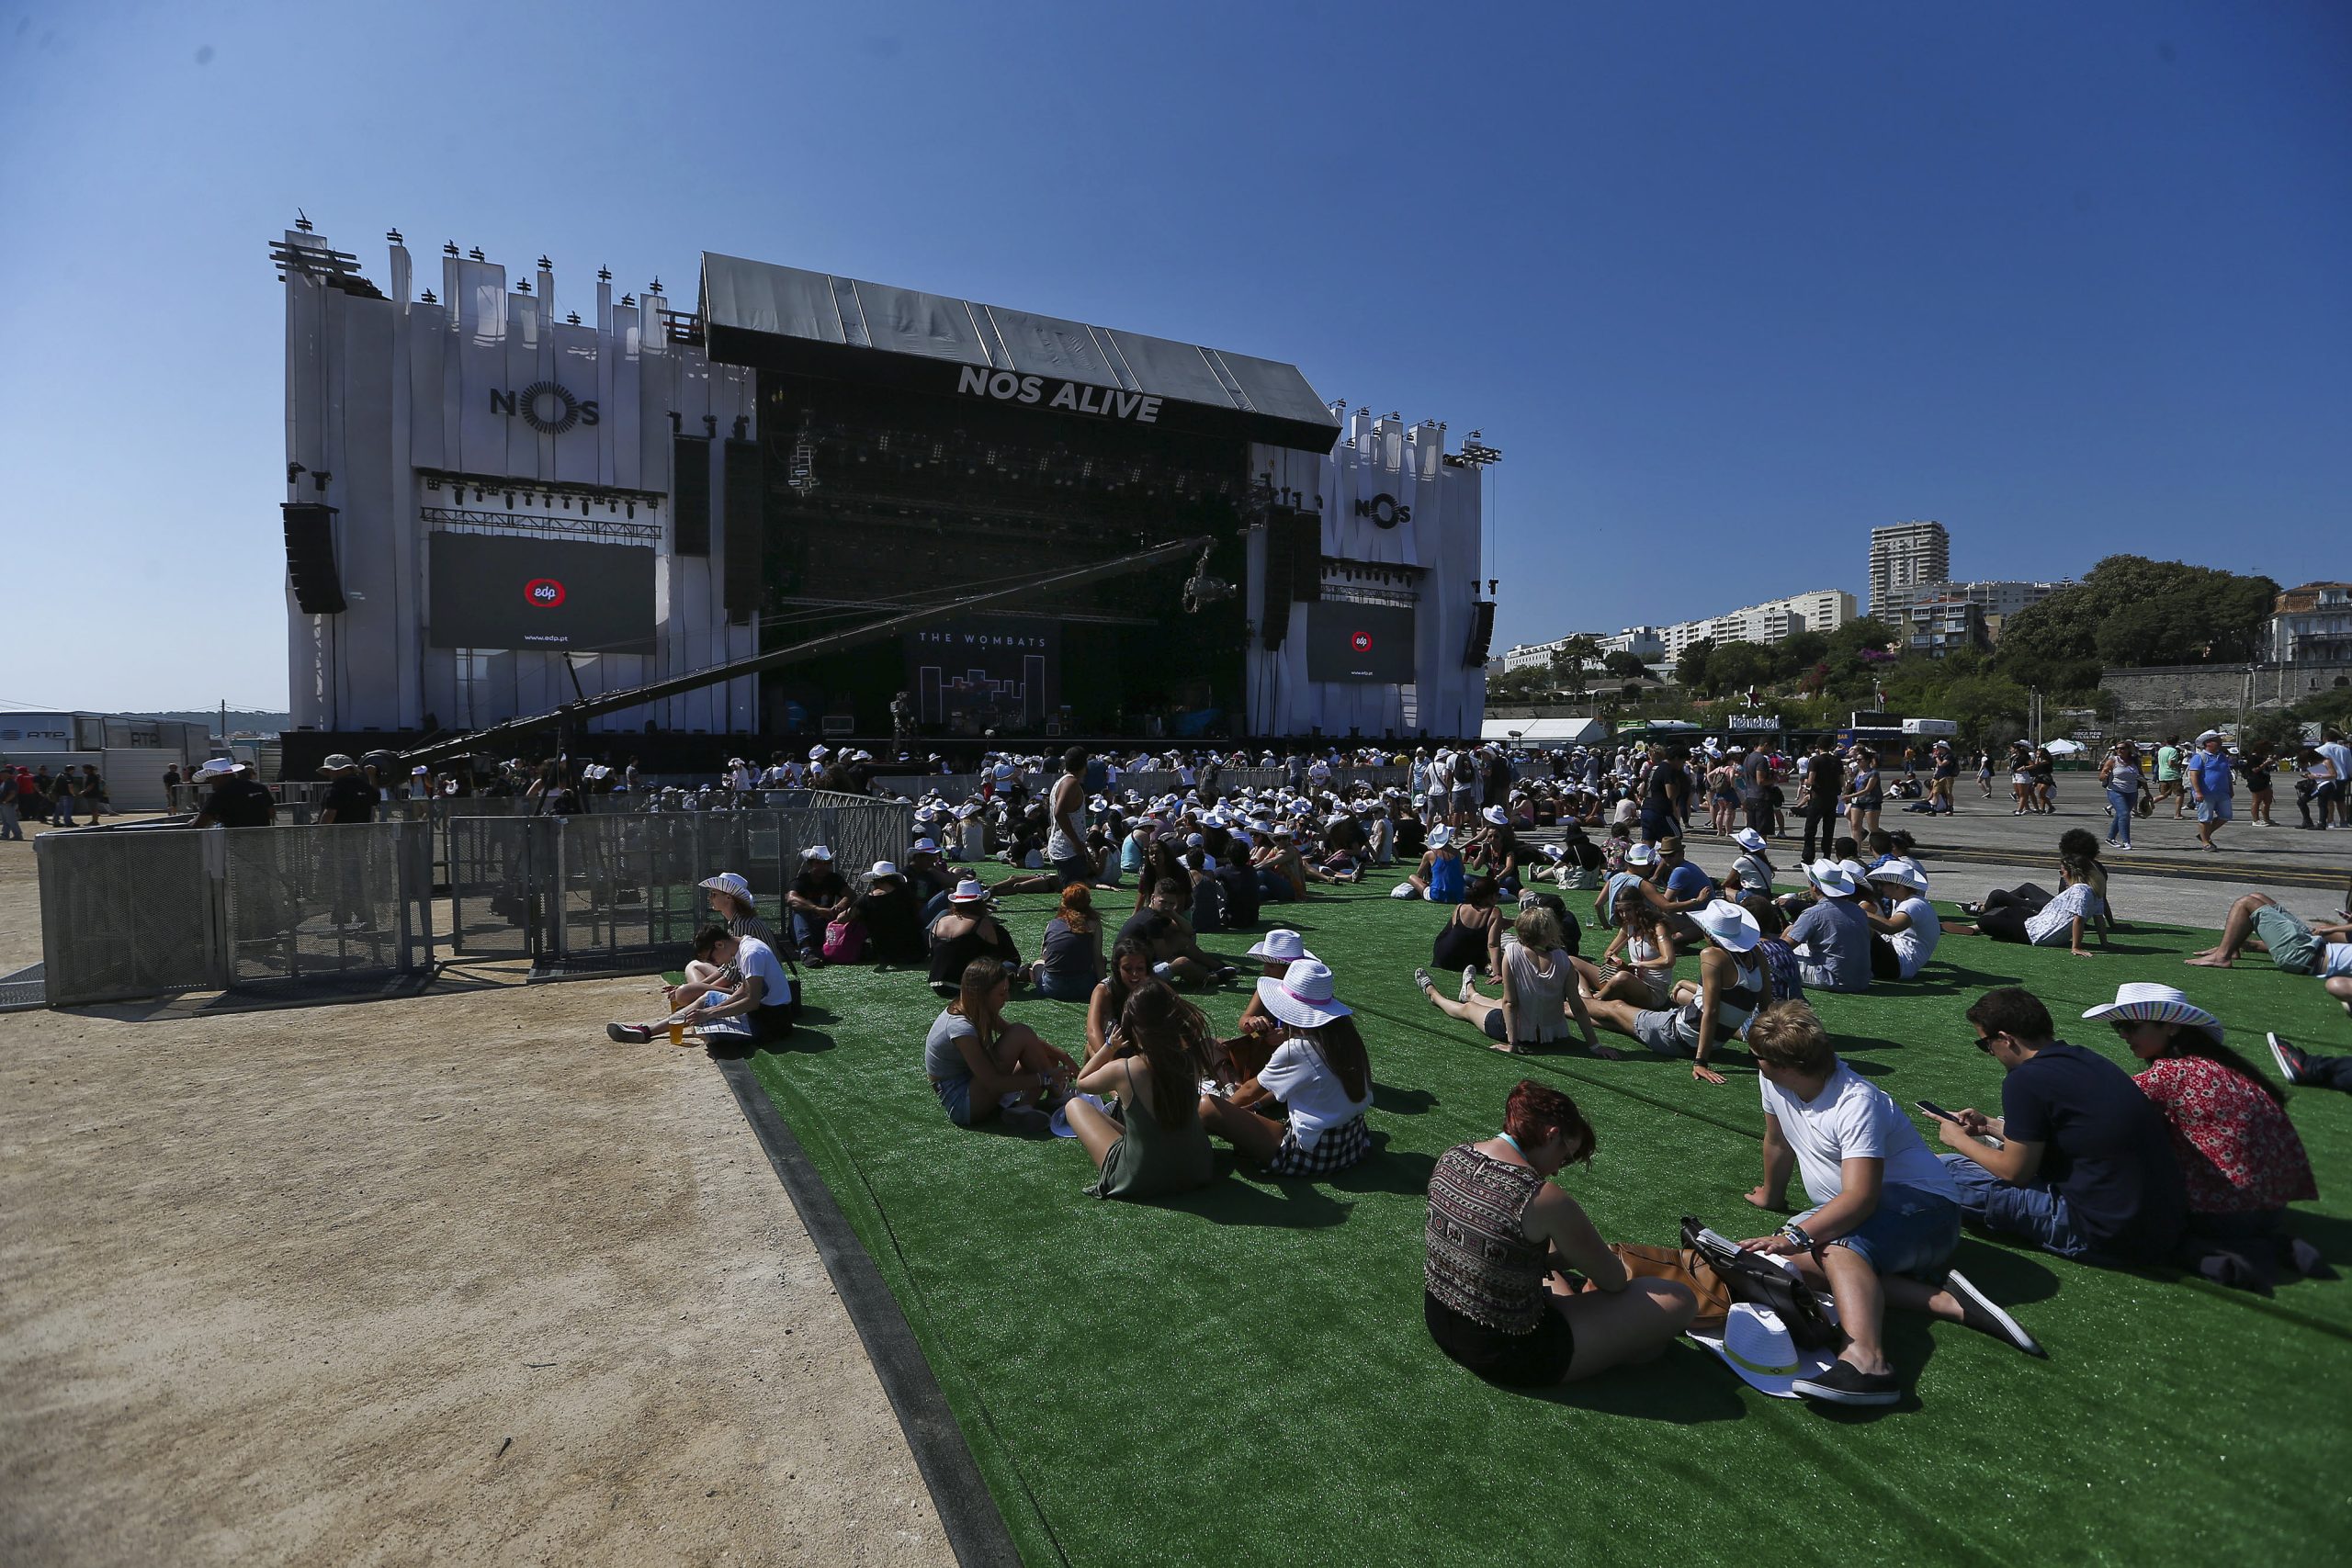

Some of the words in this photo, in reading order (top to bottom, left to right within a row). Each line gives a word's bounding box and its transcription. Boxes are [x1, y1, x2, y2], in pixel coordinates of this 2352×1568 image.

[490, 381, 600, 434] NOS
[958, 366, 1044, 403] NOS
[1049, 382, 1163, 423] ALIVE
[1355, 493, 1411, 529] NOS
[534, 586, 556, 600] edp
[920, 633, 951, 642] THE
[965, 635, 1045, 647] WOMBATS
